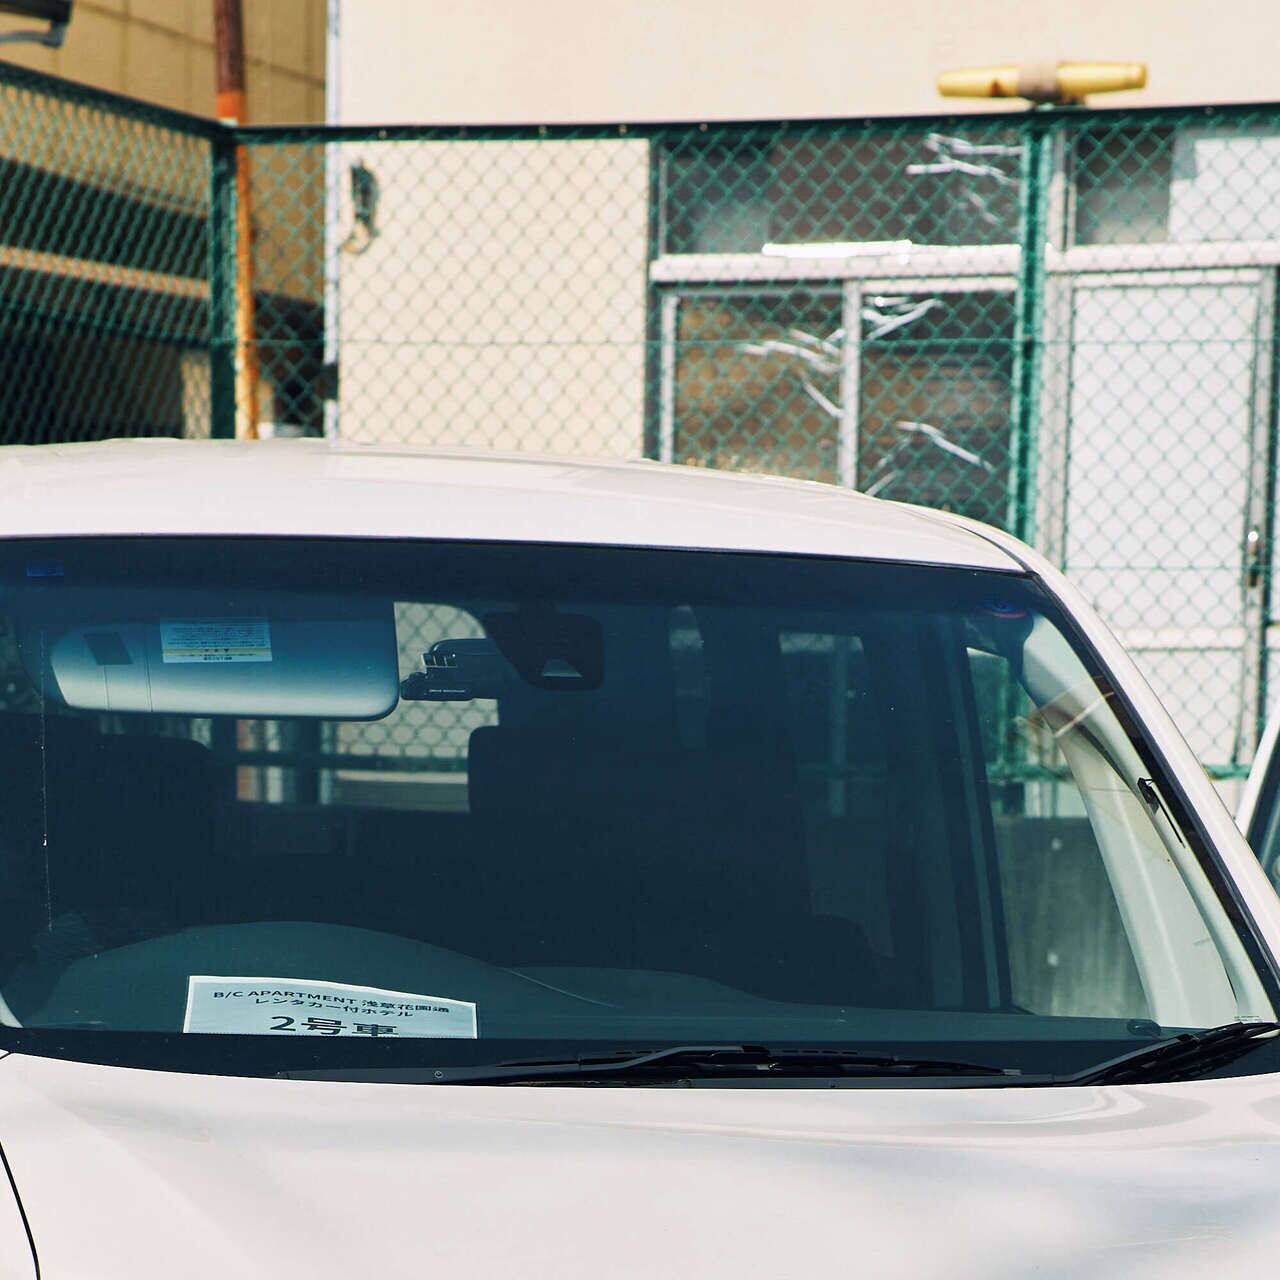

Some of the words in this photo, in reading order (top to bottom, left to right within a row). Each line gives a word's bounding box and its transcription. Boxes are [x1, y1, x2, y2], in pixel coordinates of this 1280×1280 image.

[213, 991, 244, 999] B/C
[248, 990, 357, 1005] APARTMENT
[255, 998, 414, 1017] レンタカー付ホテル
[270, 1016, 399, 1037] 2号車
